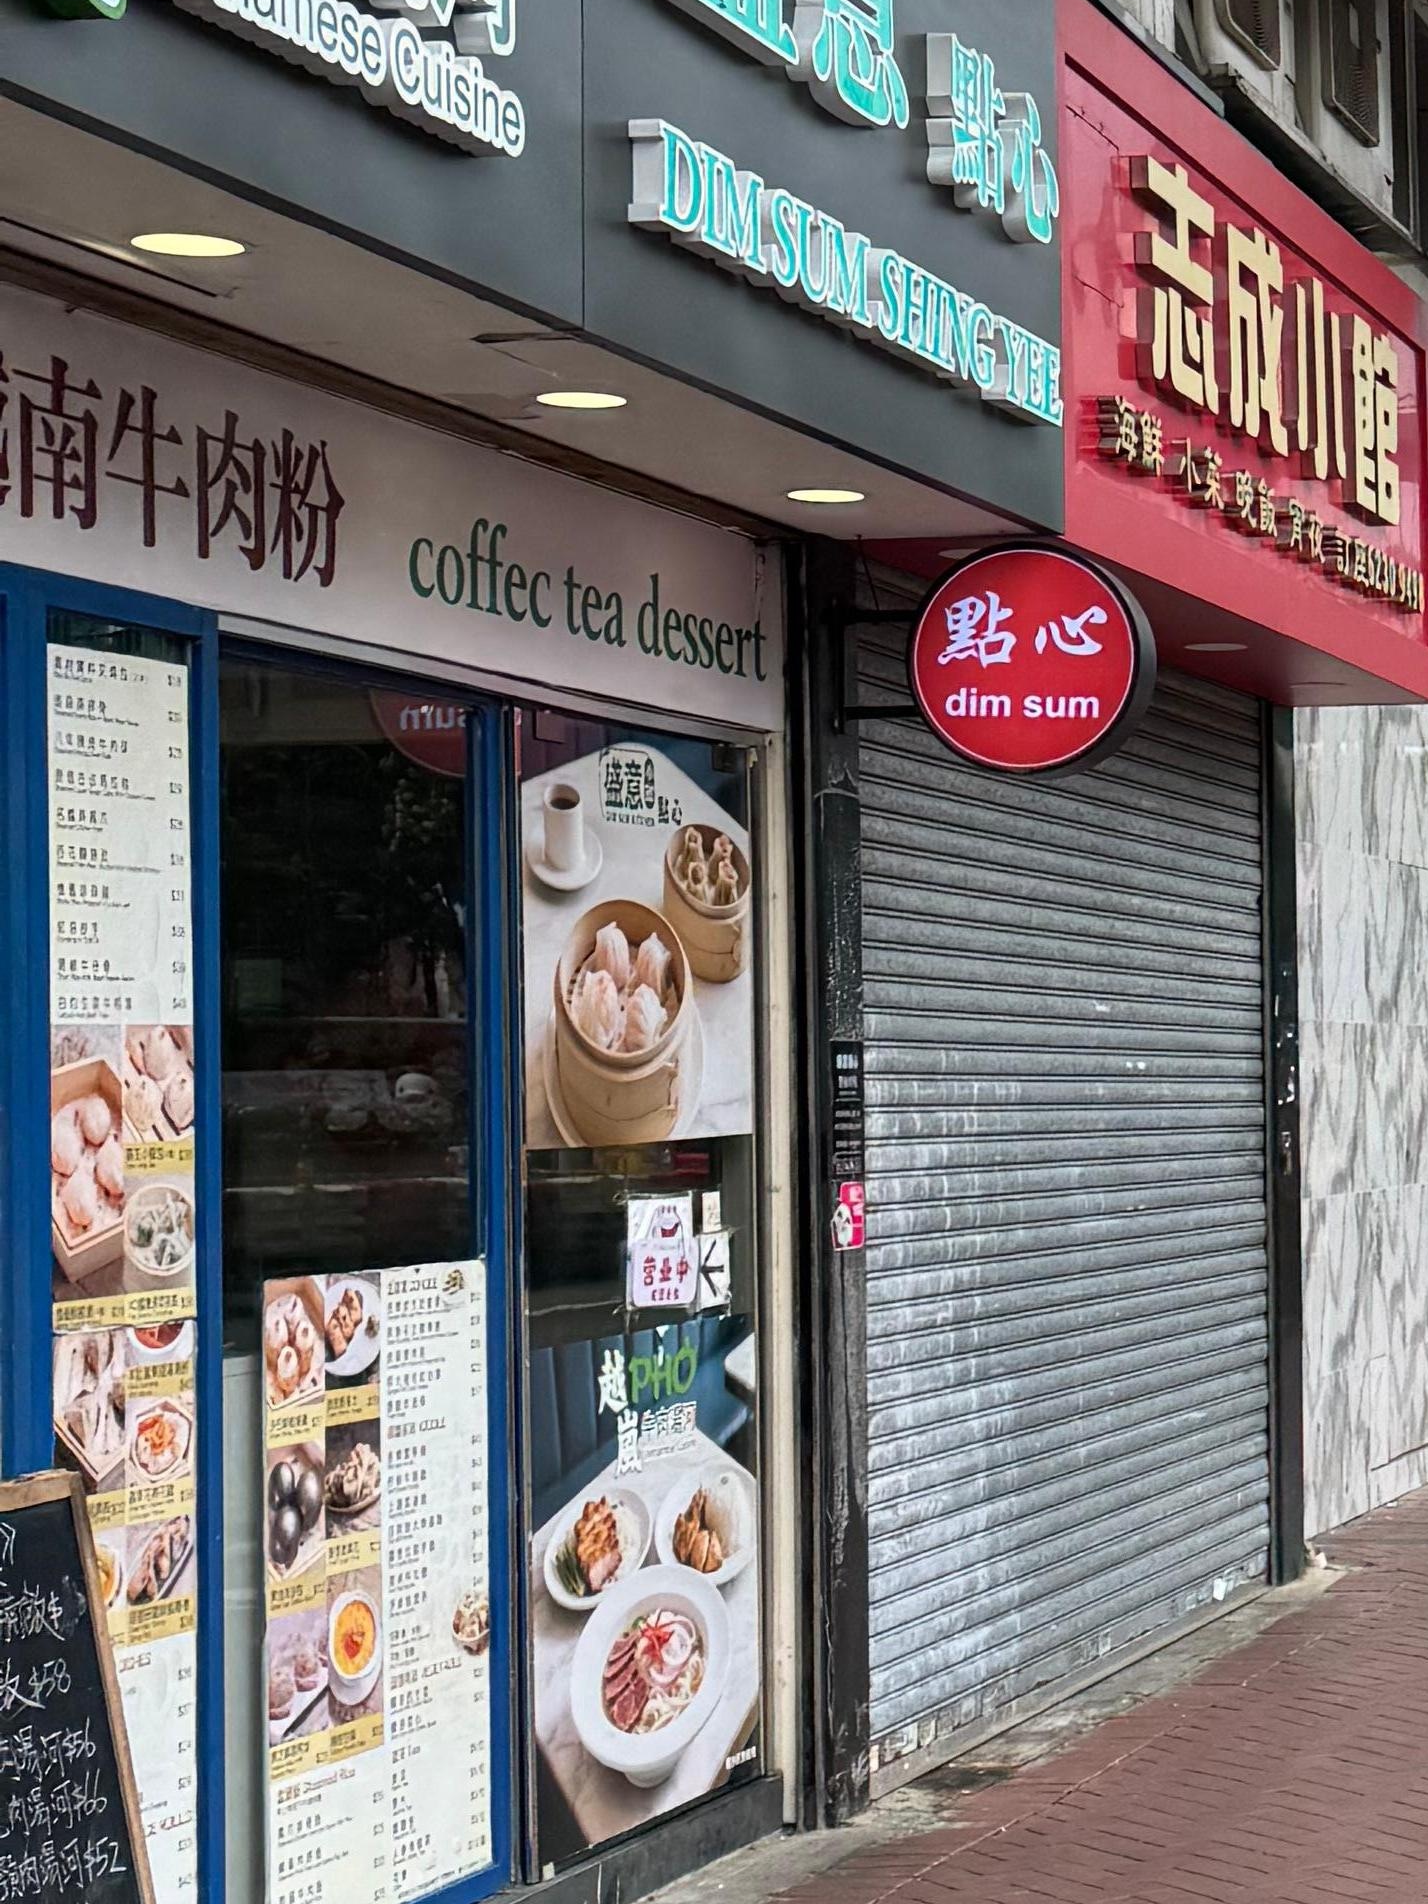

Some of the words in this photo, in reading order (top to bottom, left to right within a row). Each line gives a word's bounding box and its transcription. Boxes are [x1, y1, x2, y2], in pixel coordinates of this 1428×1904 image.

[390, 17, 526, 157] Cuisine
[952, 33, 1059, 244] 點心
[659, 119, 767, 274] DIM
[771, 189, 873, 328] SUM
[878, 249, 996, 390] SHING
[999, 316, 1062, 427] YEE
[1146, 155, 1401, 527] 志成小館
[0, 354, 345, 588] 南牛肉粉
[1114, 395, 1164, 477] 海鮮
[1179, 437, 1224, 510] 小菜
[564, 565, 626, 648] tea
[637, 572, 767, 682] dessert
[937, 590, 1108, 669] 點心
[945, 687, 1012, 718] dim
[1022, 695, 1100, 719] sum
